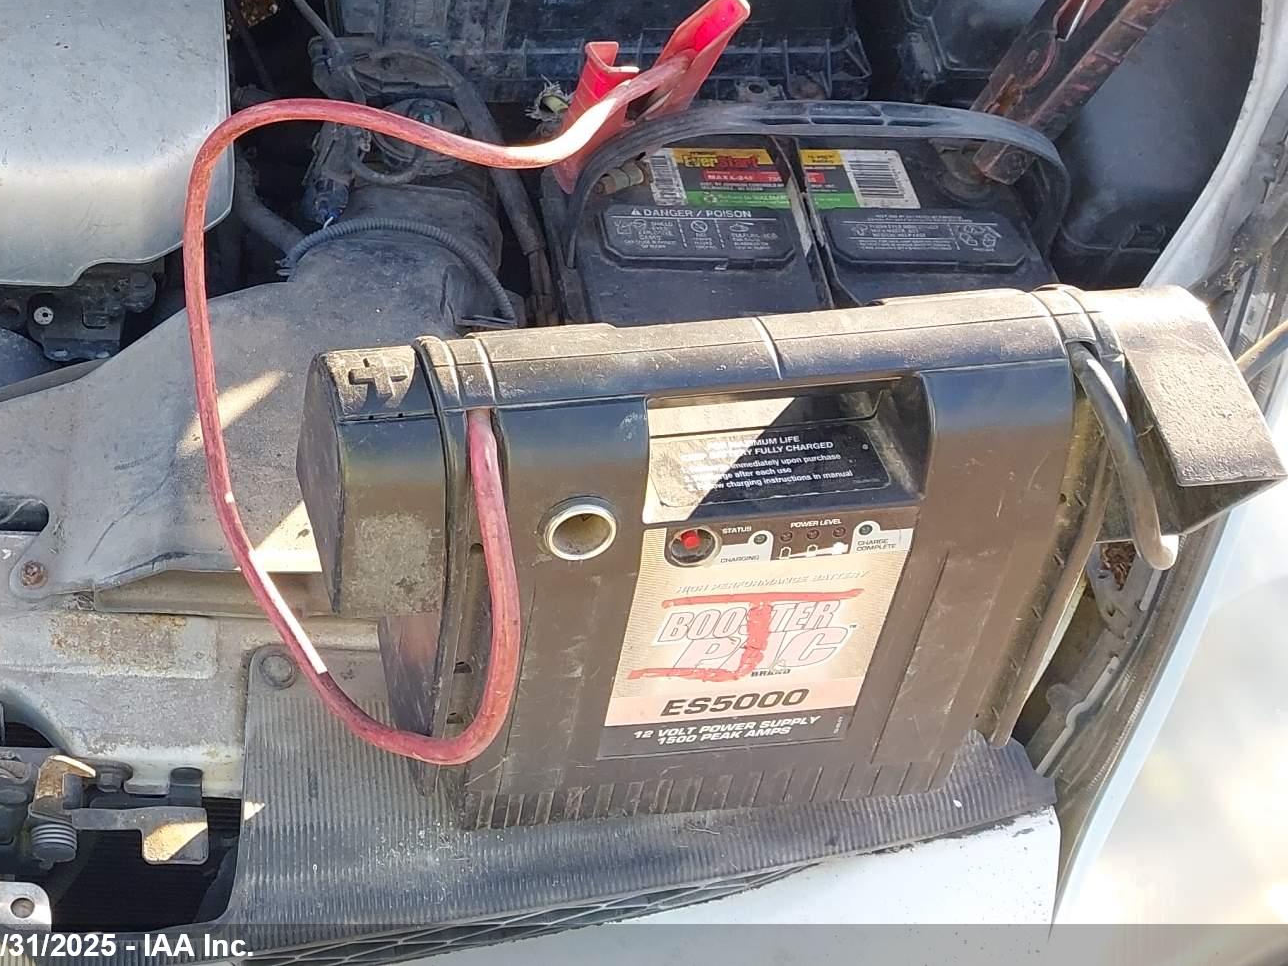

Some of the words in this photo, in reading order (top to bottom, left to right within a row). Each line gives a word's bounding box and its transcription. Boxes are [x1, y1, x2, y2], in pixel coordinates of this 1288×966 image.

[682, 153, 759, 167] EverStart
[643, 209, 693, 217] DANGER
[705, 210, 752, 218] POISON
[779, 435, 800, 444] LIFE
[754, 446, 784, 456] FULLY
[785, 441, 834, 452] CHARGED
[781, 458, 802, 466] upon
[804, 453, 842, 464] purchase
[734, 469, 754, 478] after
[755, 467, 776, 476] each
[726, 478, 763, 489] charging
[763, 474, 812, 485] instructions
[823, 470, 854, 479] manual
[790, 520, 819, 529] POWER
[819, 518, 843, 527] LEVEL
[721, 526, 752, 535] STATUS
[856, 543, 897, 552] COMPLETE
[857, 538, 889, 546] CHARGE
[720, 555, 761, 564] CHARGING
[710, 575, 809, 591] PERFORMANCE
[657, 600, 841, 643] BOOTER
[660, 688, 810, 717] ES5000
[633, 730, 654, 739] 12
[658, 726, 695, 738] VOLT
[699, 722, 757, 734] POWER
[759, 715, 821, 729] SUPPLY
[657, 735, 697, 746] 1500
[700, 730, 741, 742] PEAK
[743, 726, 792, 738] AMPS
